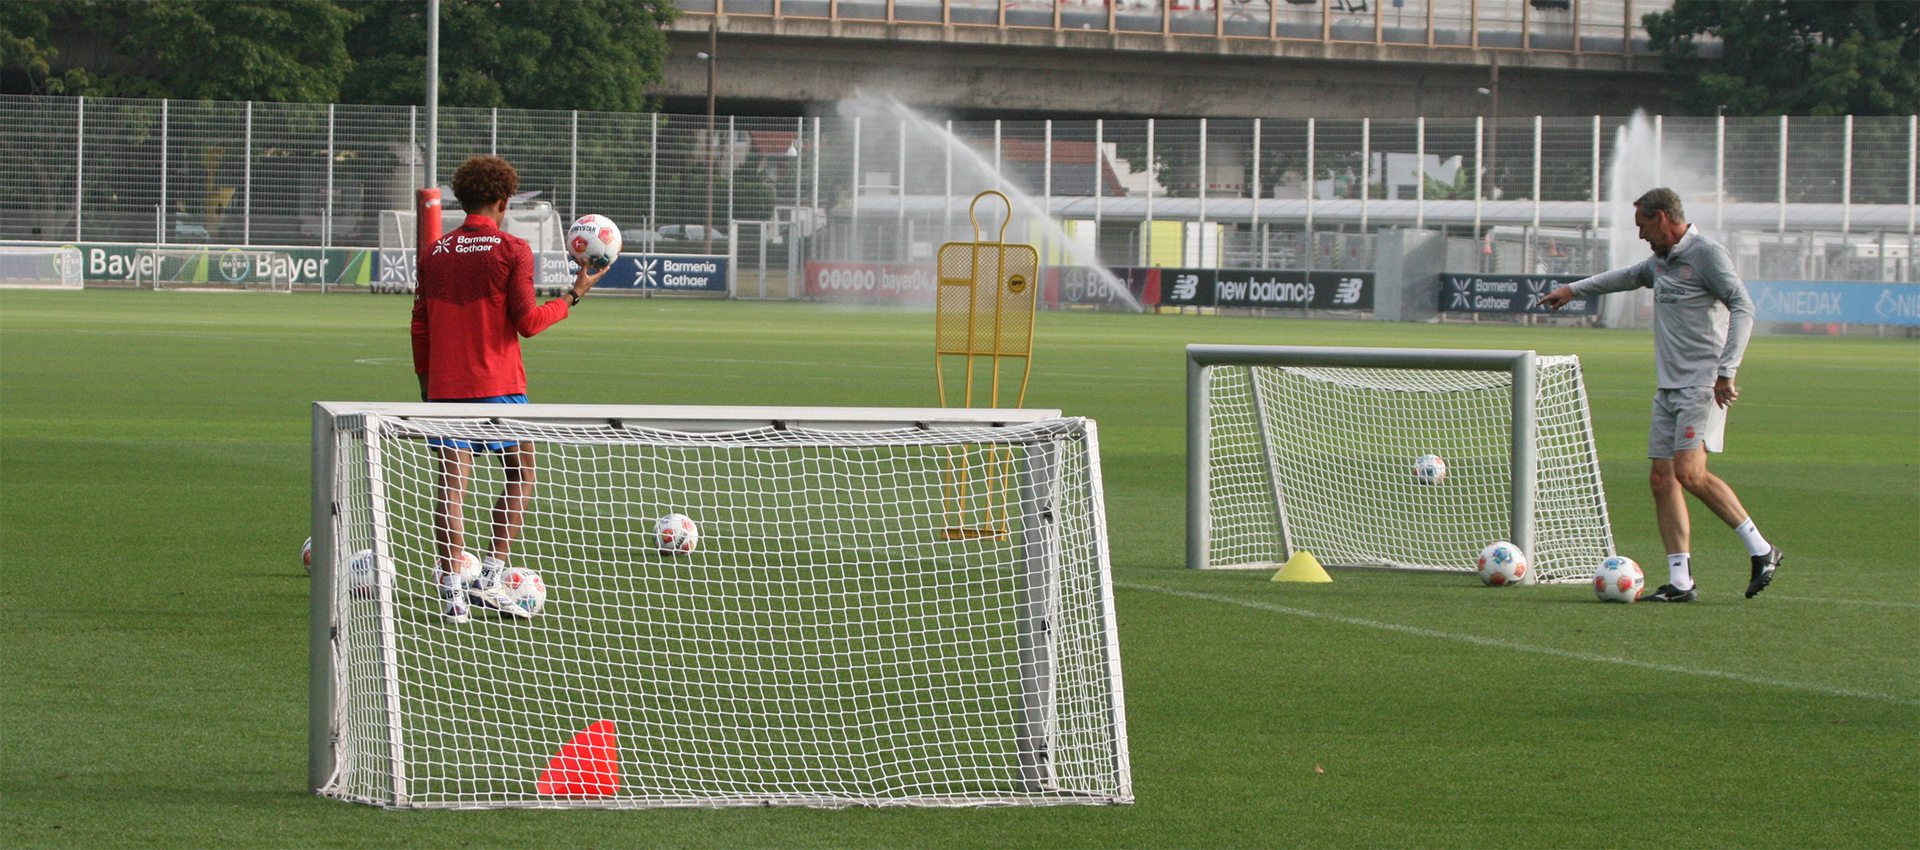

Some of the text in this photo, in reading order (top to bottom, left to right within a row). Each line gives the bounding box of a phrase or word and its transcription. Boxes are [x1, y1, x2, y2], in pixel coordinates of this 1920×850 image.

[457, 235, 501, 244] Barmenia
[455, 244, 493, 253] Gothaer
[90, 248, 166, 279] Bayer
[256, 253, 329, 282] Bayer
[663, 259, 717, 272] Barmenia
[663, 273, 709, 286] Gothaer
[1475, 278, 1518, 292] Barmenia
[1216, 276, 1316, 302] new balance
[1475, 295, 1512, 309] Gothaer
[1777, 290, 1843, 315] NIEDAX
